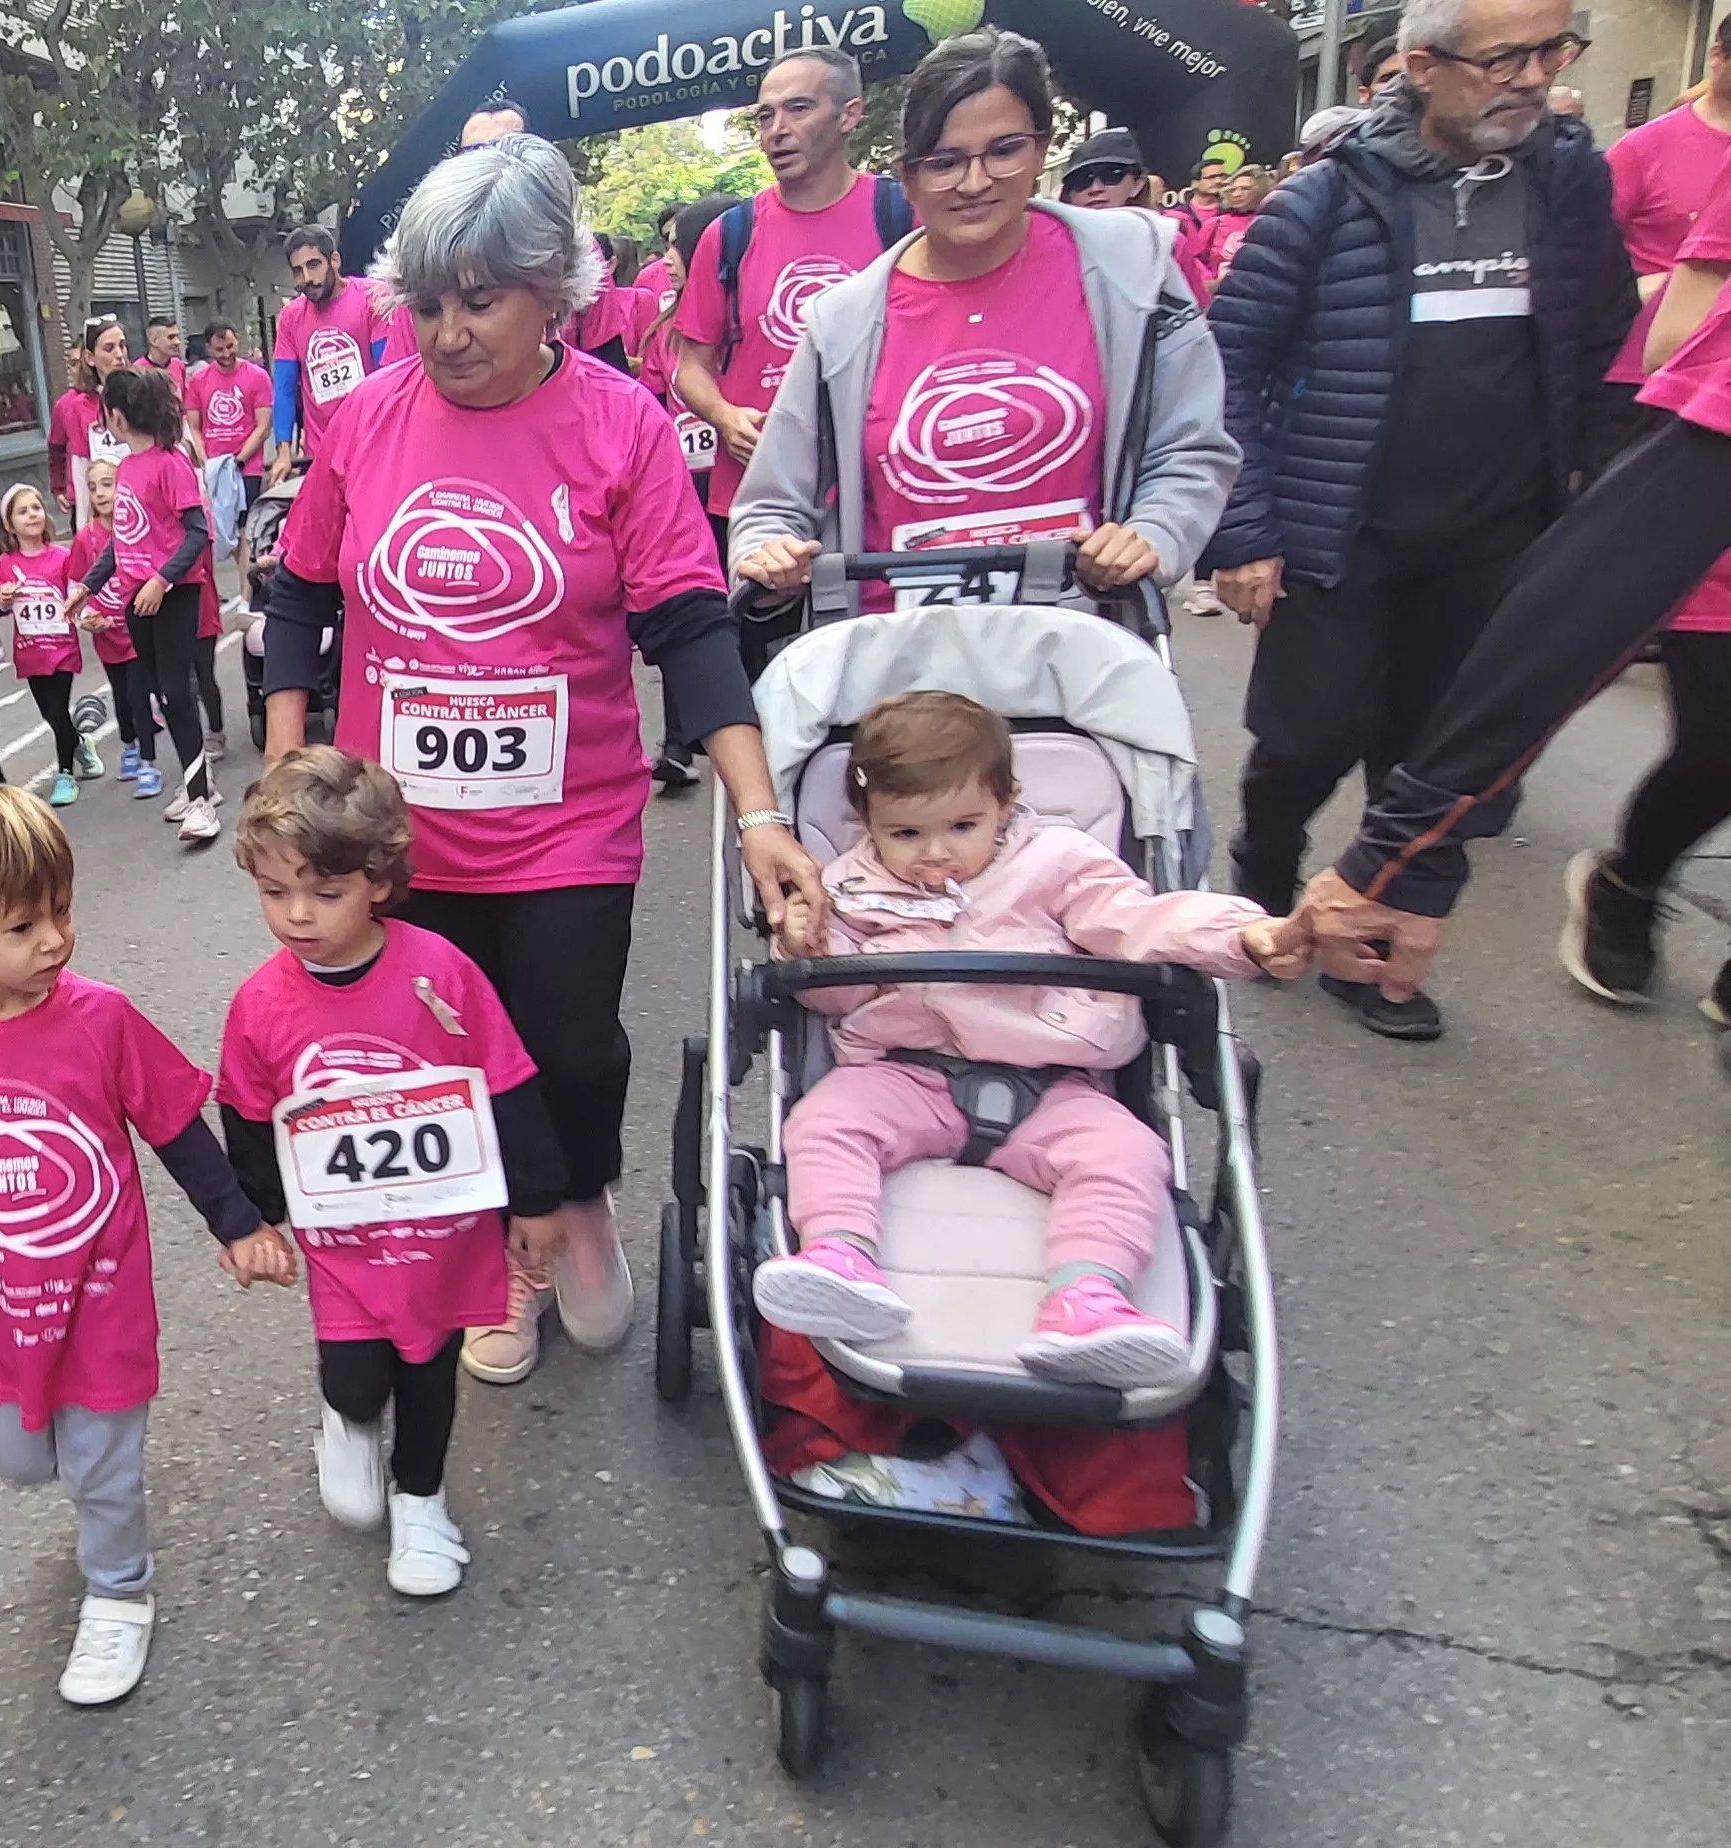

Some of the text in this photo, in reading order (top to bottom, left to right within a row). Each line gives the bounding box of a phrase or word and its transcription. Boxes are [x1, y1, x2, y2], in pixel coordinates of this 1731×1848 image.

[1133, 16, 1170, 47] vive
[1168, 40, 1227, 78] mejor
[567, 4, 889, 118] podoactiva
[613, 76, 740, 112] PODOLOGÍA Y
[320, 365, 352, 388] 832
[417, 545, 481, 562] Caminemos
[417, 560, 474, 580] JUNTOS
[20, 603, 56, 621] 419
[400, 702, 548, 720] CONTRA EL CÁNCER
[449, 696, 495, 706] HUESCA
[416, 725, 527, 773] 903
[326, 1123, 451, 1183] 420
